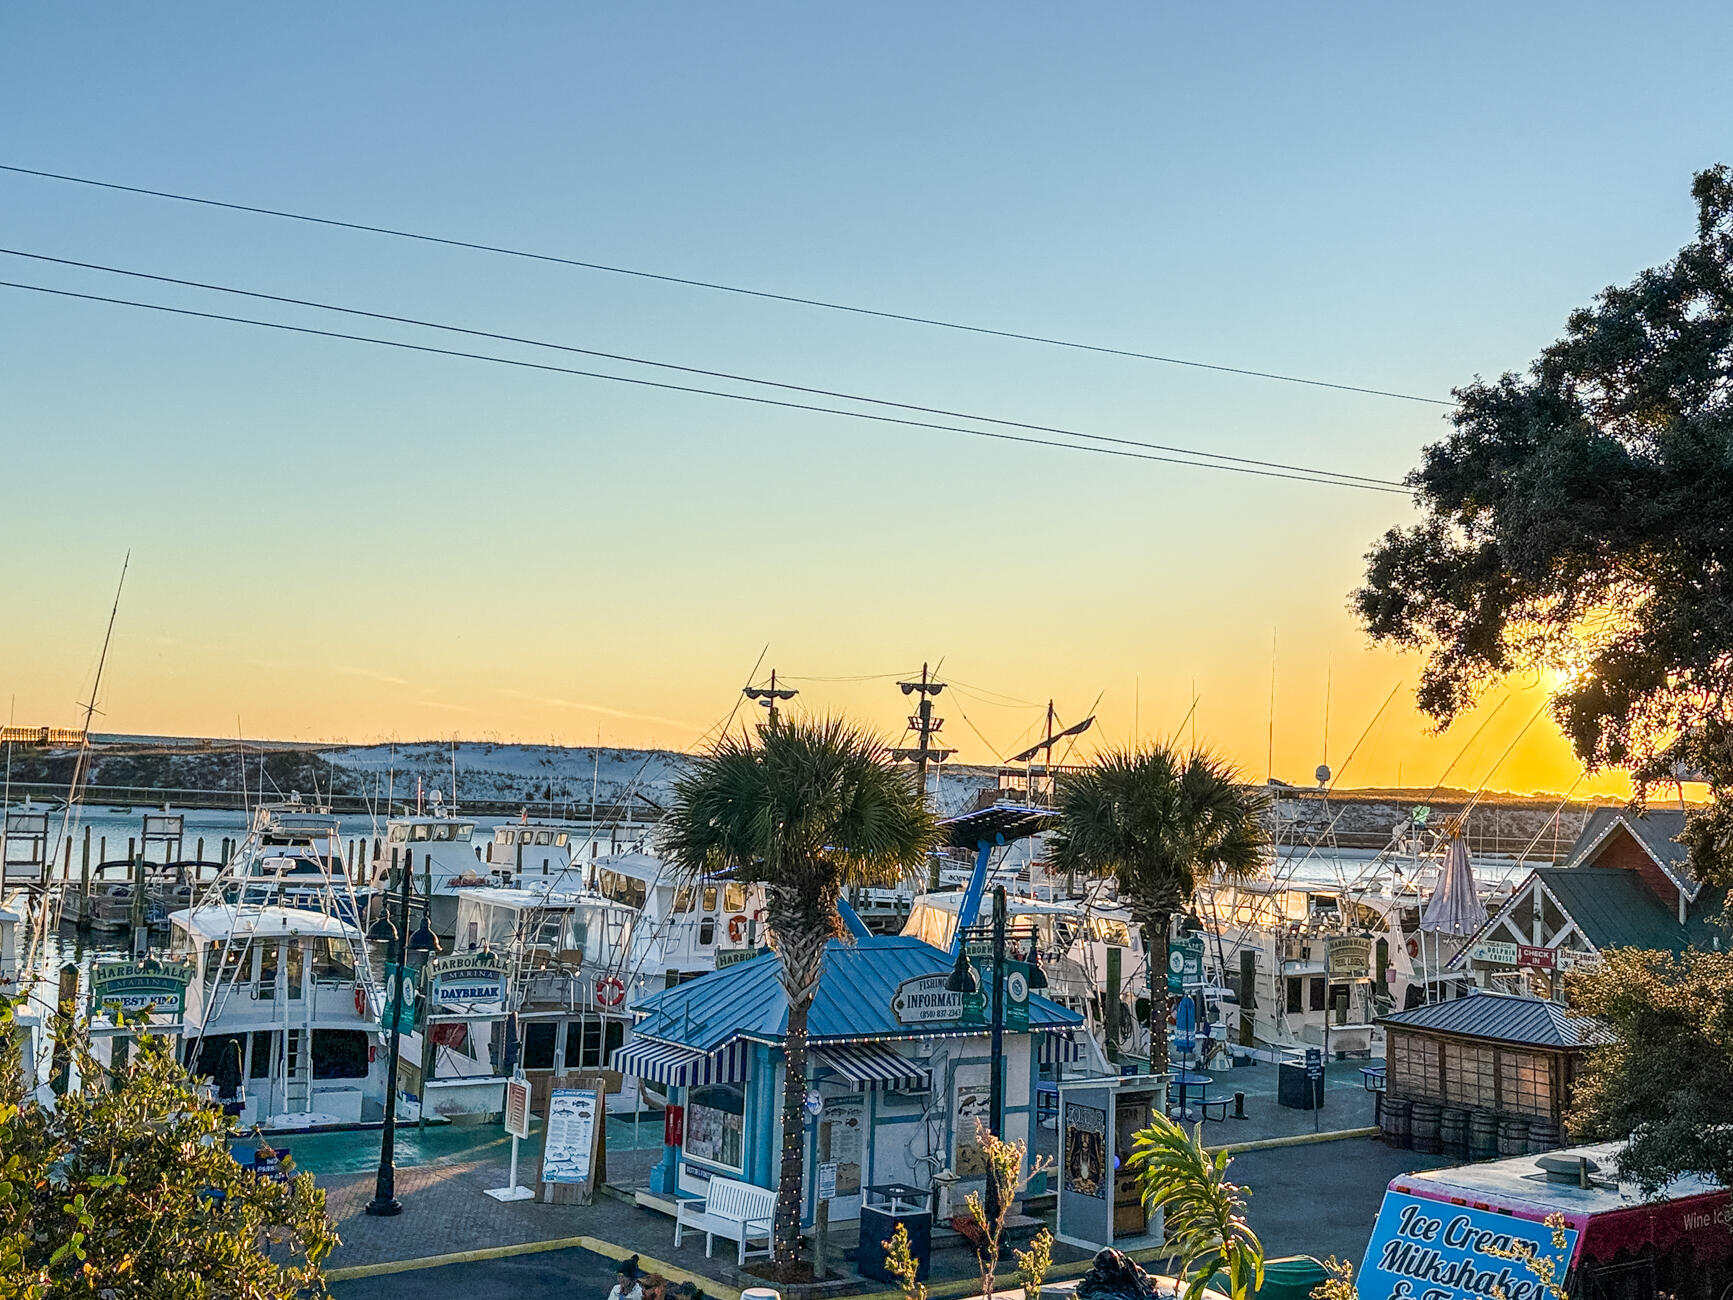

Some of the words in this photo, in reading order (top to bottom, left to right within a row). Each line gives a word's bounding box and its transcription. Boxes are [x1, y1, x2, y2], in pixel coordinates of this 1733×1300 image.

[1487, 946, 1515, 956] DOLPHIN
[1489, 953, 1513, 962] CRUISE
[1523, 949, 1550, 958] CHECK
[433, 958, 508, 973] HARBORWALK
[719, 952, 758, 966] HARBOR
[449, 970, 493, 978] MARINA
[440, 986, 499, 999] DAYBREAK
[150, 995, 178, 1006] KIND
[907, 992, 961, 1009] INFORMATI
[920, 1010, 935, 1020] (850)
[1683, 1211, 1711, 1230] Wine
[1398, 1204, 1440, 1240] Ice
[1443, 1214, 1539, 1263] Cream
[1378, 1240, 1546, 1300] Milkshakes
